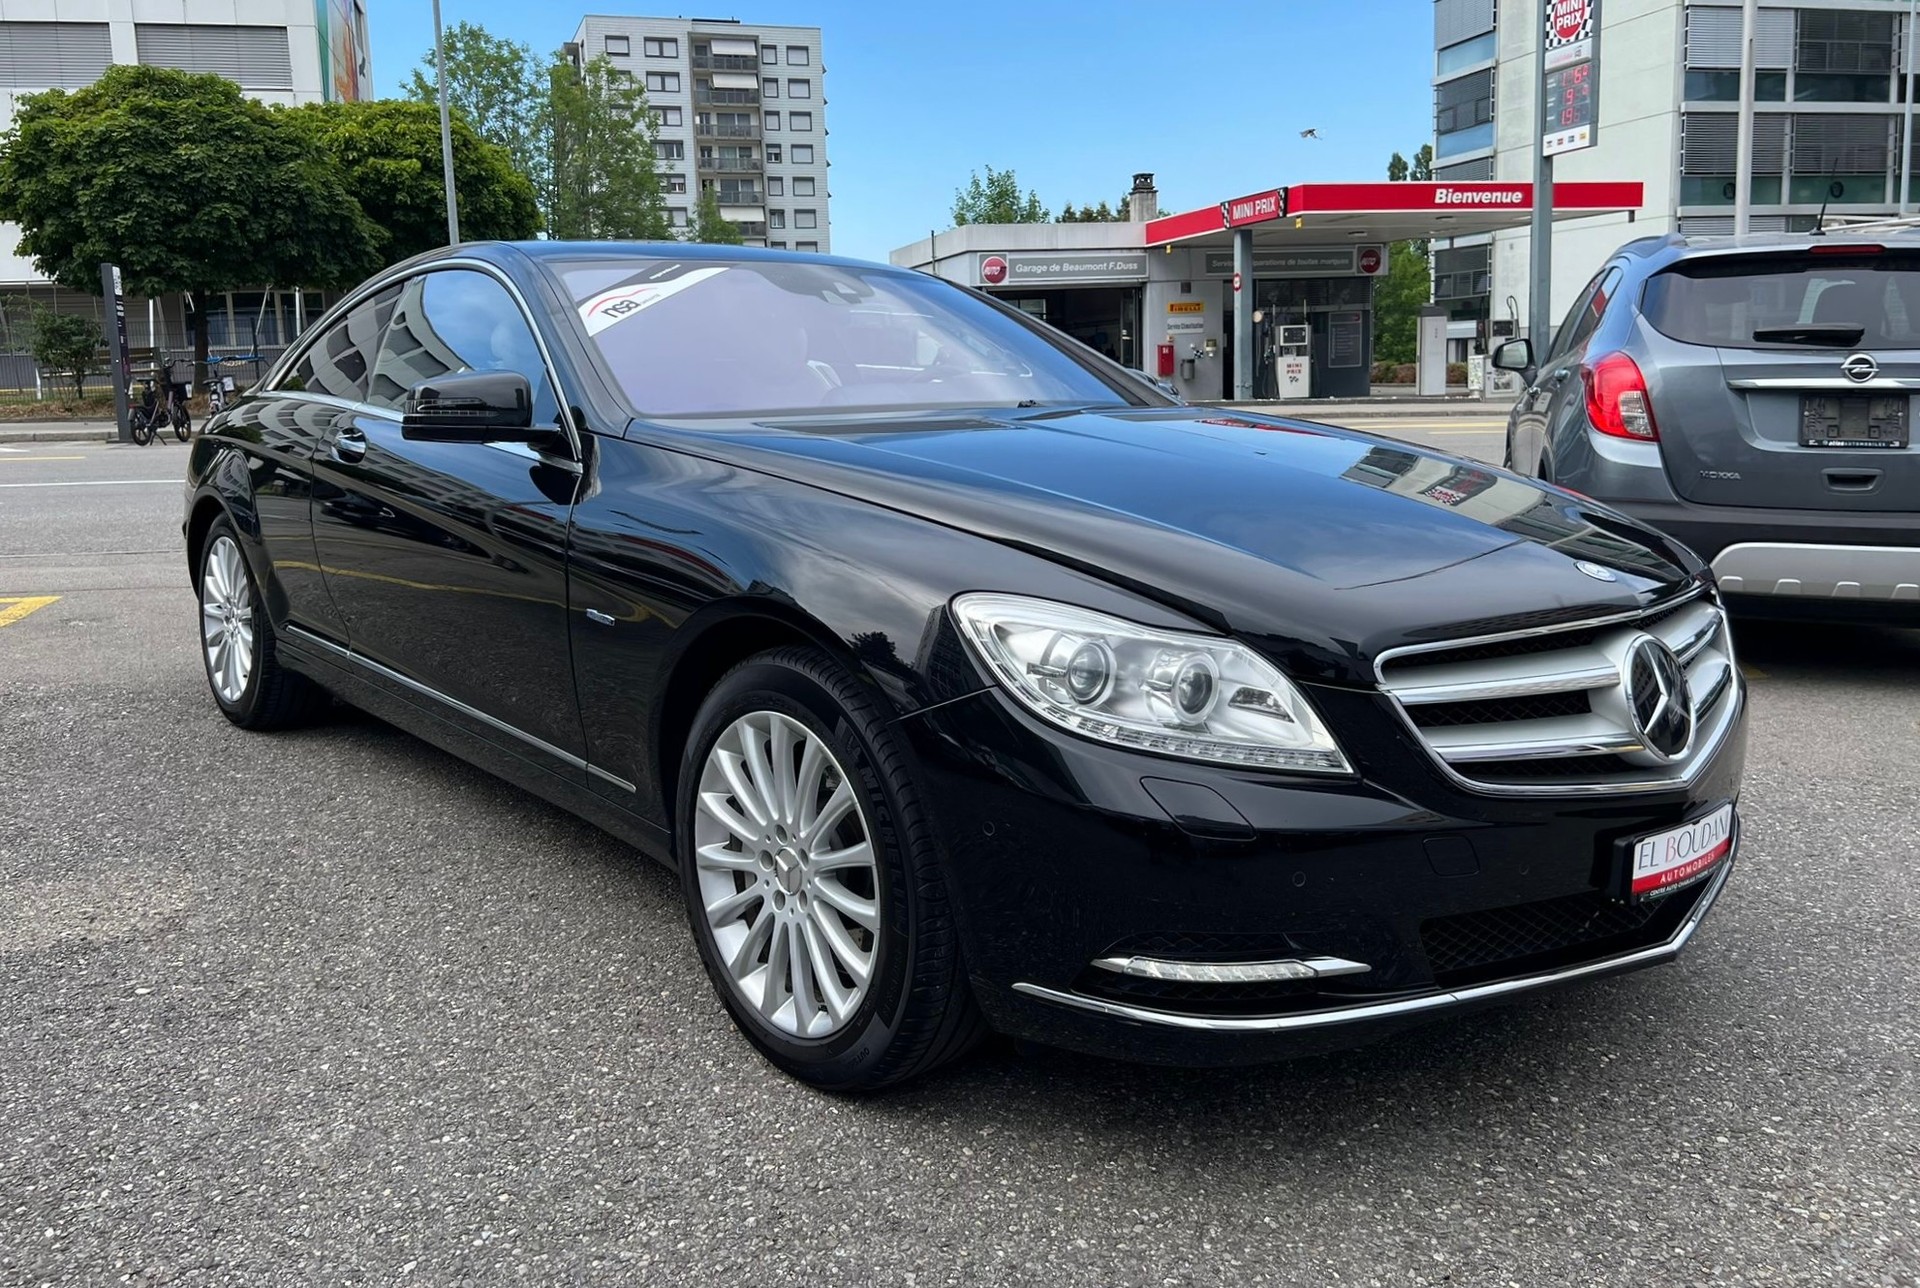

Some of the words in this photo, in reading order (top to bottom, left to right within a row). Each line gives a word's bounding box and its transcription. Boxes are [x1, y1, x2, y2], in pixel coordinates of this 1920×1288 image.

[1556, 0, 1583, 16] MINI
[1556, 10, 1583, 31] PRIX
[1434, 188, 1523, 204] Bienvenue
[1232, 202, 1254, 220] MINI
[1254, 196, 1276, 215] PRIX
[1015, 263, 1048, 274] Garage
[1049, 263, 1061, 272] de
[1062, 262, 1108, 272] Beaumont
[1108, 261, 1139, 271] F.Duss
[601, 299, 641, 318] nsa
[1638, 841, 1659, 870] EL
[1665, 811, 1729, 863] BOUDAN
[1660, 852, 1715, 884] AUTOMOBILES
